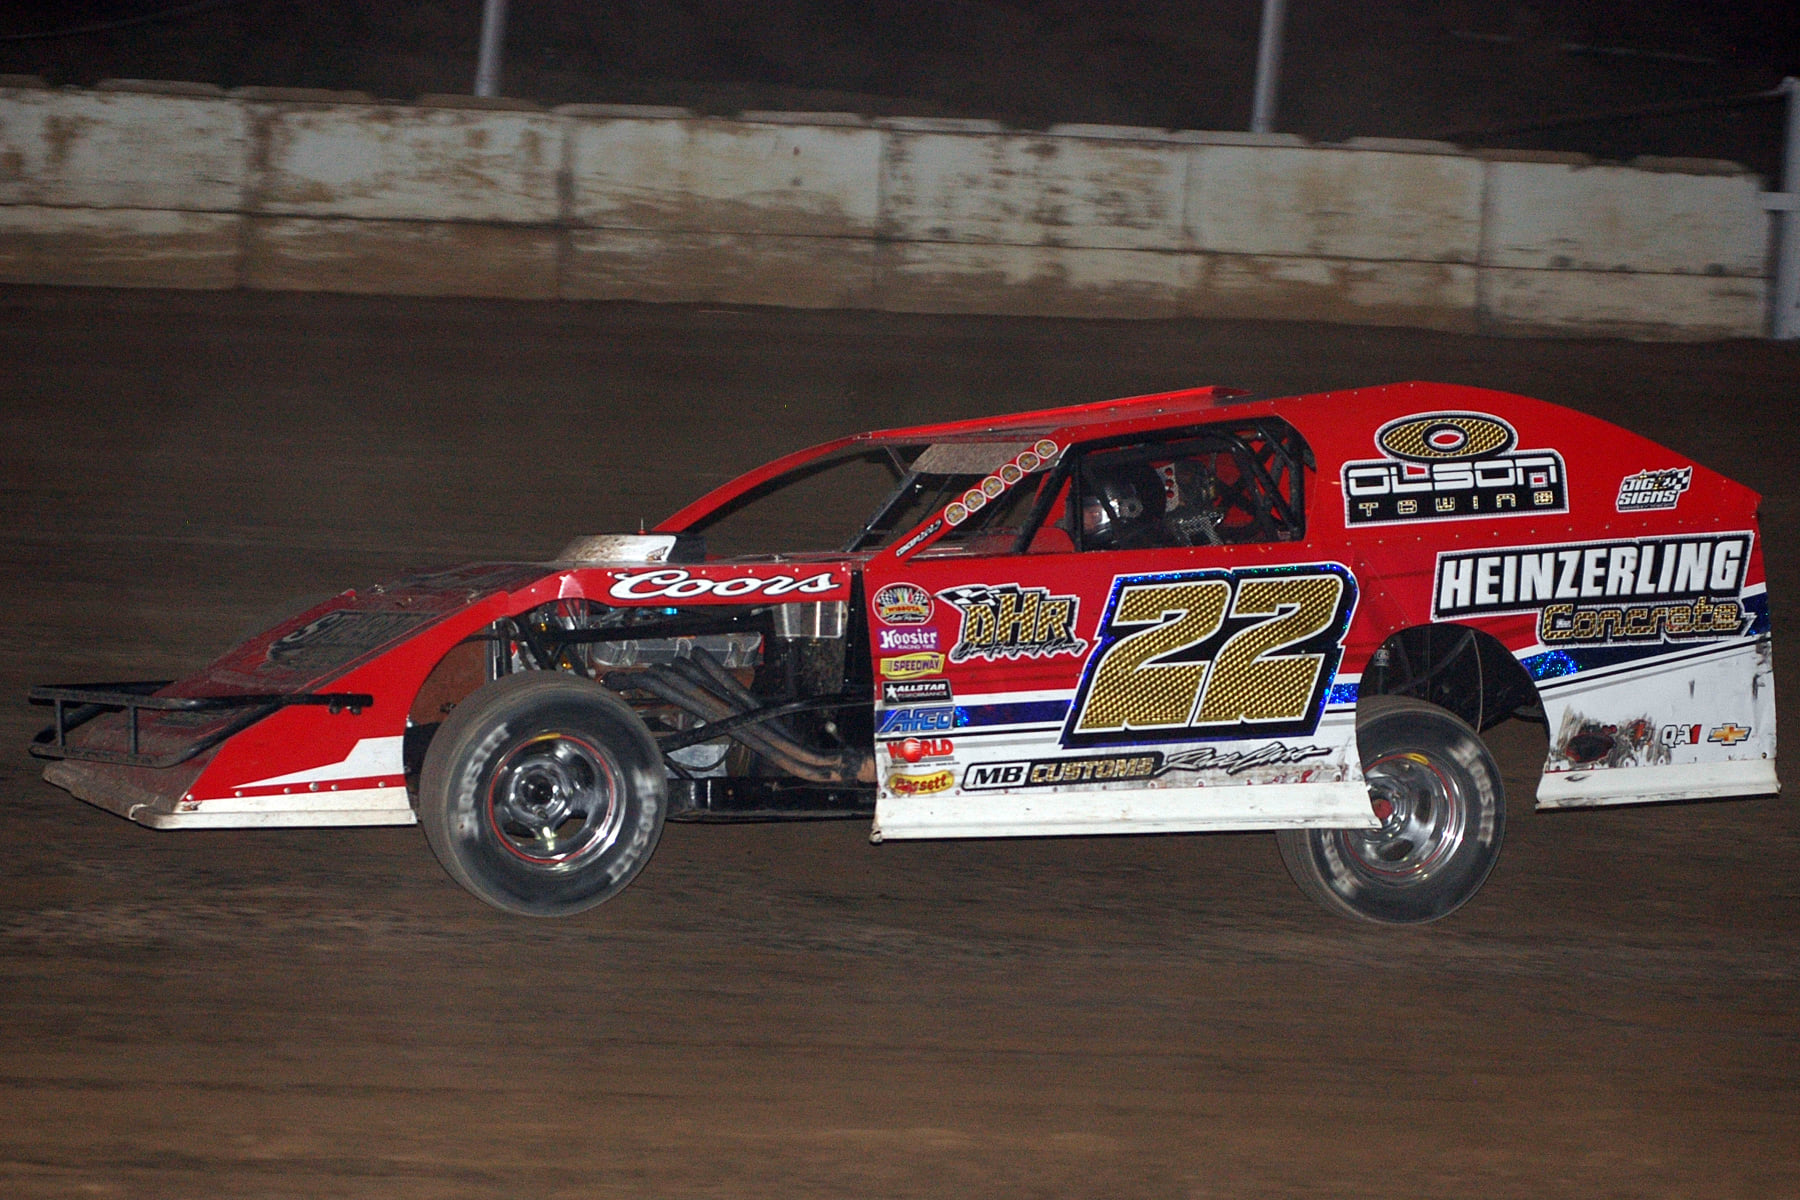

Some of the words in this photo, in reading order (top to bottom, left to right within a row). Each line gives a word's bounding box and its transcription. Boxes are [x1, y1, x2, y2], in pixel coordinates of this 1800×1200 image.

[1619, 490, 1677, 505] SIGNS
[609, 569, 841, 600] Coors
[1439, 540, 1743, 610] HEINZERLING
[963, 591, 1071, 645] DHR
[1543, 596, 1741, 641] Concrete
[880, 628, 938, 649] Hoosier
[893, 660, 940, 671] SPEEDWAY
[1074, 574, 1343, 734] 22
[896, 683, 946, 692] ALLSTAR
[1661, 724, 1702, 748] QA1
[886, 737, 955, 763] WORLD
[973, 766, 1024, 785] MB
[1030, 757, 1154, 783] CUSTOMS
